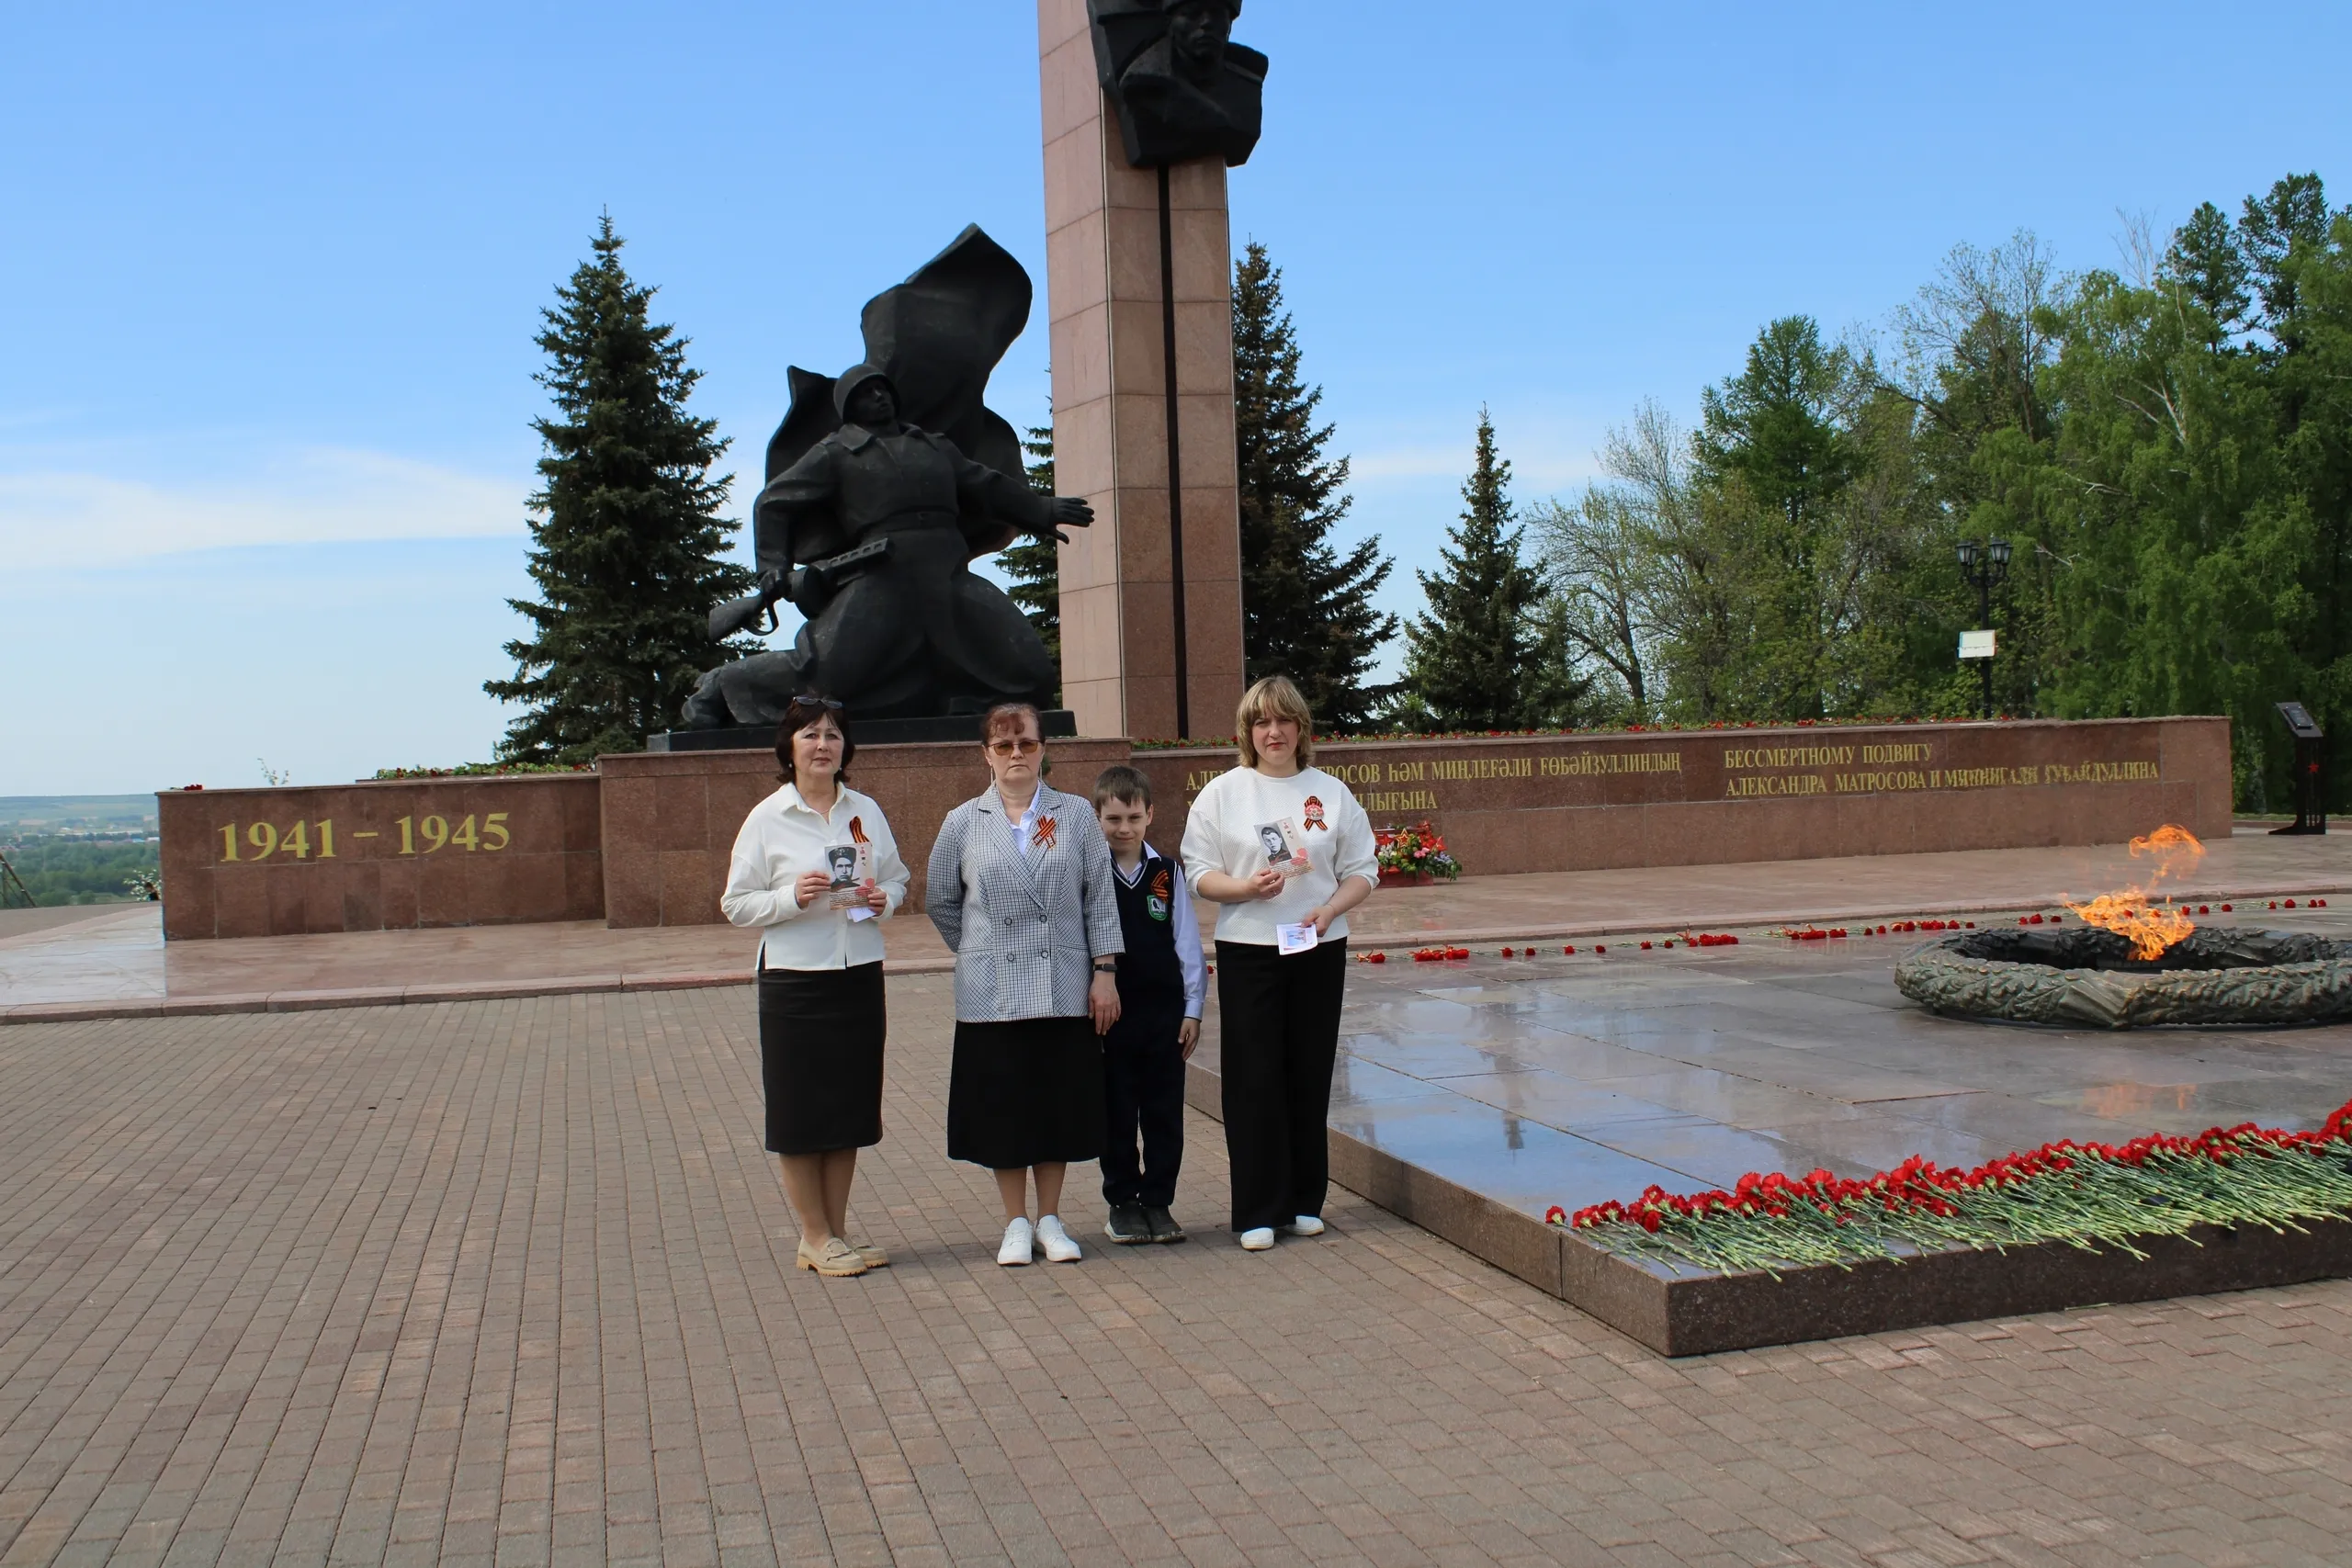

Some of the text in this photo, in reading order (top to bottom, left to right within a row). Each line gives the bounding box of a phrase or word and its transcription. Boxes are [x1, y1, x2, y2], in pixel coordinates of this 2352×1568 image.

[1724, 743, 1933, 769] БЕССМЕРТНОМУ ПОДВИГУ
[1317, 763, 1381, 784] РОСОВ
[1725, 774, 1827, 796] АЛЕКСАНДРА
[1835, 771, 1927, 793] МАТРОСОВА
[1930, 770, 1940, 788] И
[218, 818, 337, 863] 1941
[394, 812, 510, 854] 1945
